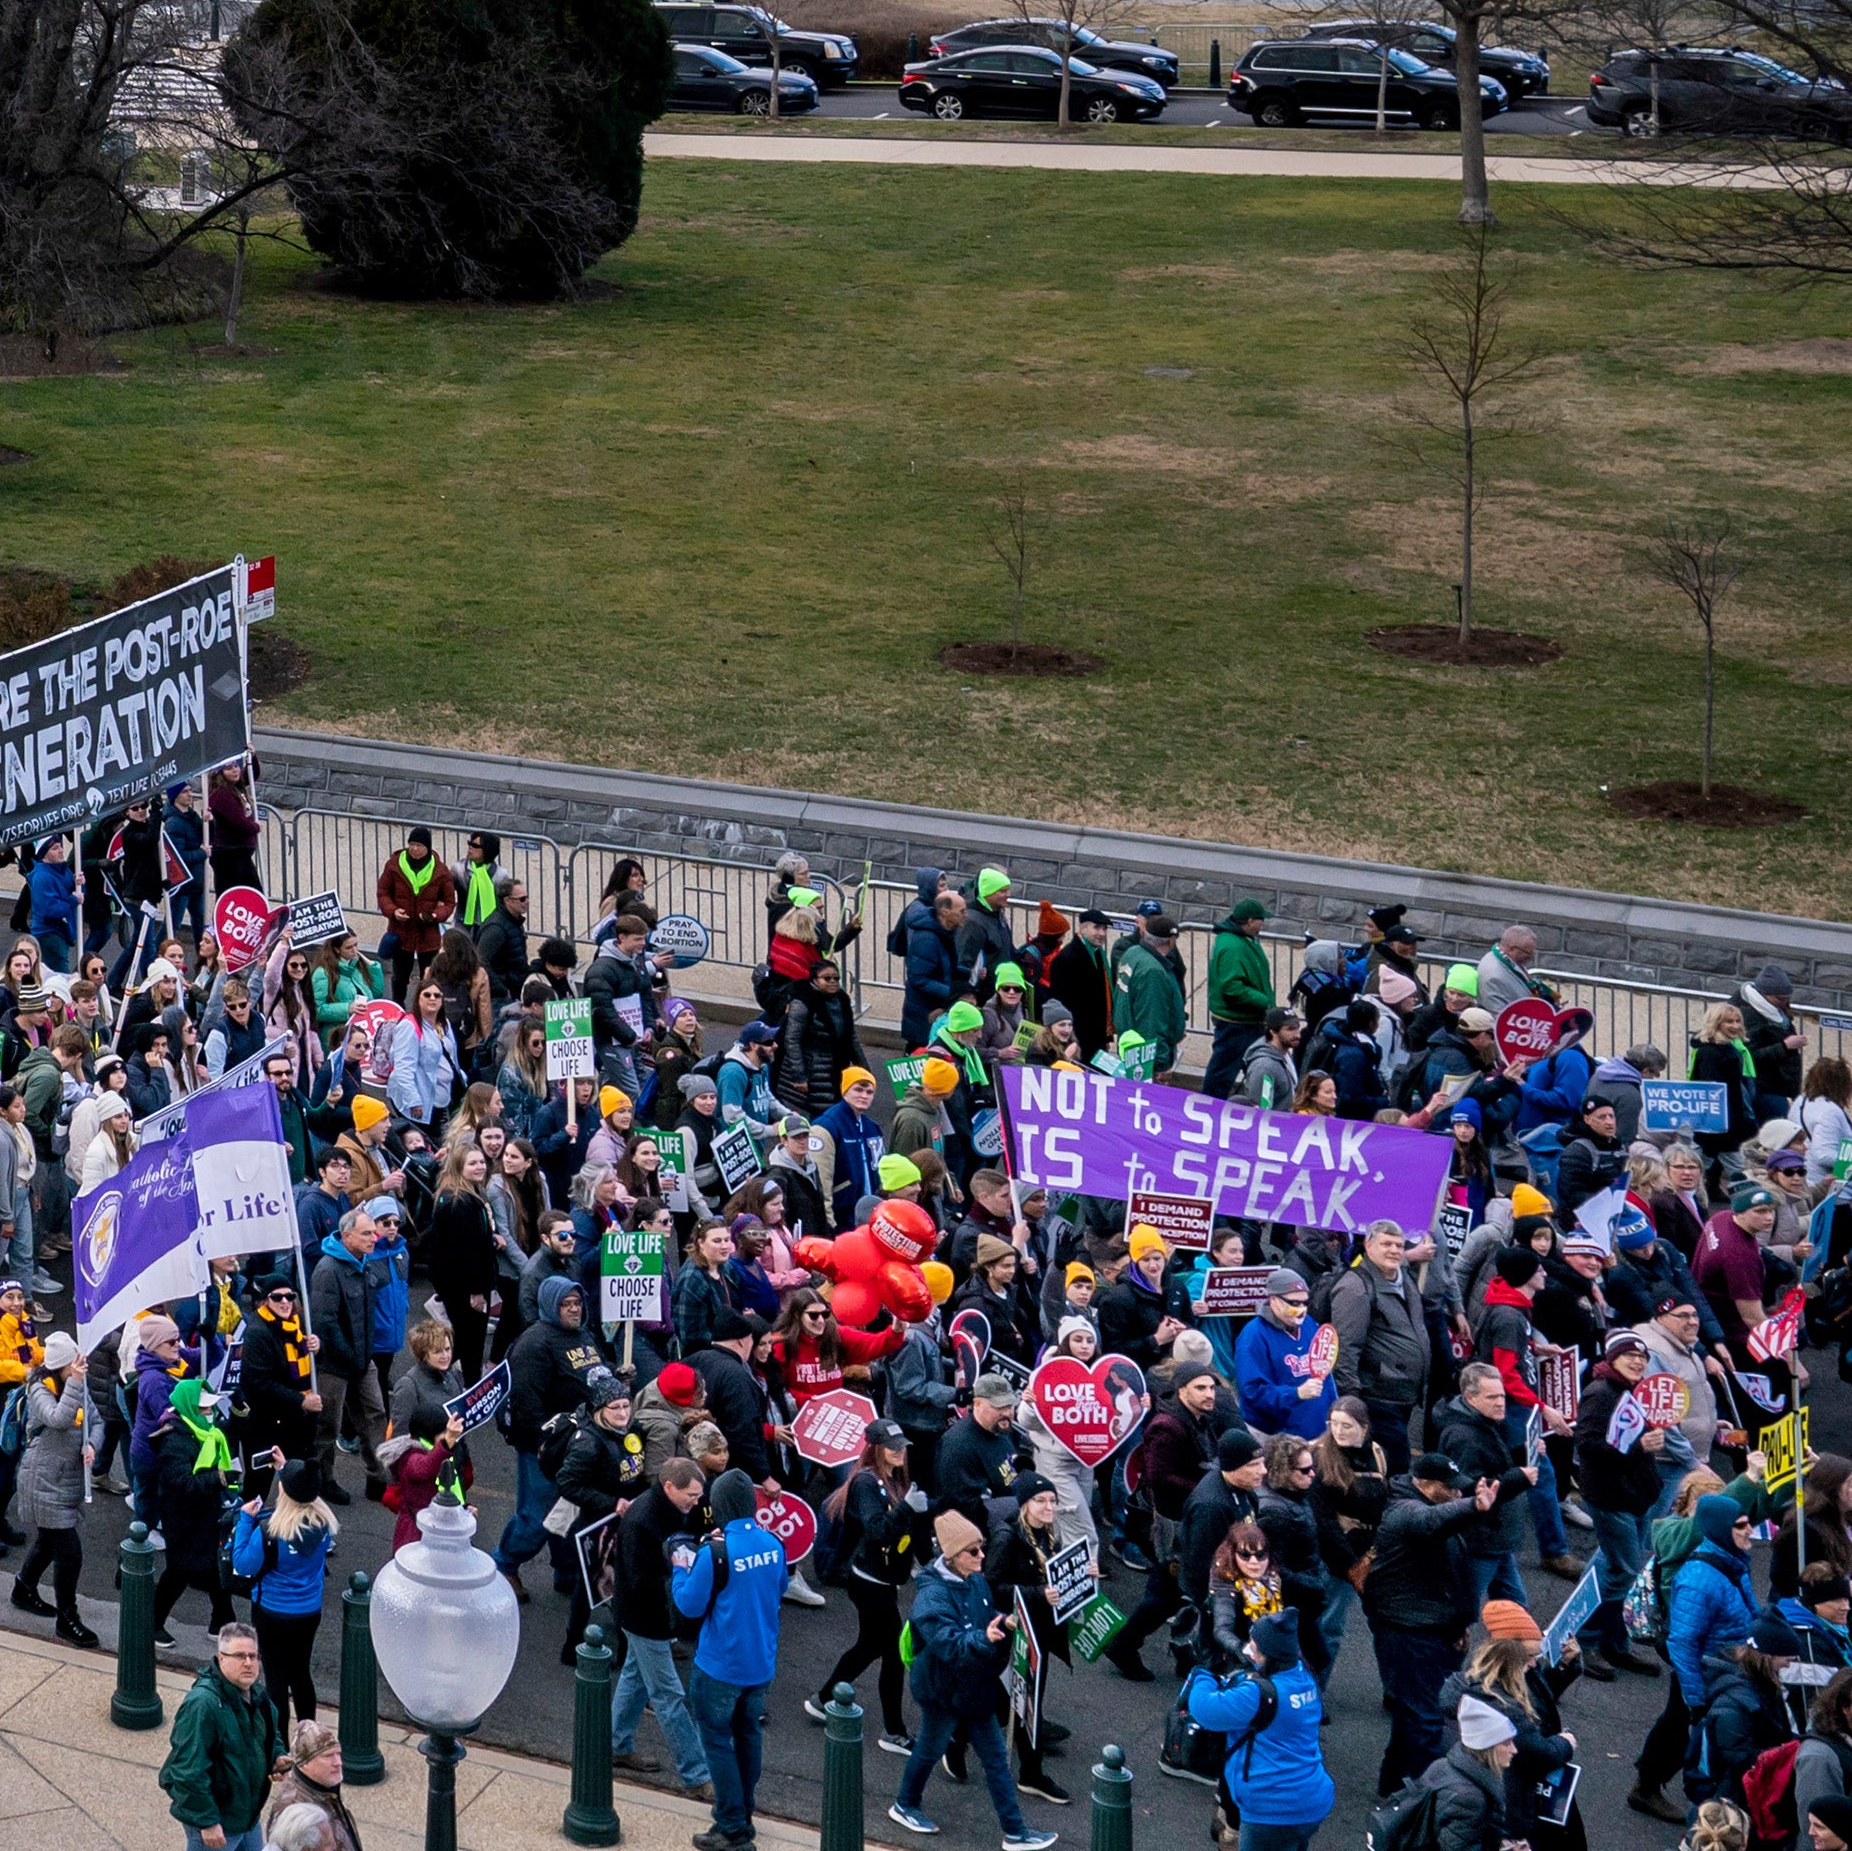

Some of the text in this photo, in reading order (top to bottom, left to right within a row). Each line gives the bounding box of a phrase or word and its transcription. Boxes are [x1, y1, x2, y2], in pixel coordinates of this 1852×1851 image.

[39, 646, 97, 714] THE
[105, 590, 233, 690] POST-ROE
[107, 784, 129, 802] TEXT
[131, 776, 148, 794] LIFE
[225, 901, 266, 927] LOVE
[296, 898, 333, 918] AM THE
[288, 909, 339, 928] POST-ROE
[668, 920, 692, 928] PRAY
[222, 916, 263, 946] BOTH
[293, 920, 342, 940] GENERATION
[678, 930, 698, 938] END
[654, 936, 703, 947] ABORTION
[547, 1001, 590, 1021] LOVE LIFE
[1507, 1014, 1553, 1033] LOVE
[551, 1039, 588, 1059] CHOOSE
[1504, 1031, 1552, 1050] BOTH
[560, 1058, 580, 1076] LIFE
[1021, 1067, 1115, 1124] NOT
[1127, 1087, 1162, 1136] to
[1647, 1087, 1706, 1100] WE VOTE
[1647, 1099, 1720, 1115] PRO-LIFE
[658, 1136, 681, 1154] LIFE
[1018, 1124, 1084, 1188] IS
[1123, 1152, 1161, 1192] to
[224, 1193, 288, 1223] Life!
[1149, 1202, 1203, 1217] DEMAND
[1130, 1213, 1210, 1230] PROTECTION
[1625, 1219, 1647, 1233] FLINT
[607, 1234, 662, 1254] LOVE LIFE
[610, 1278, 654, 1297] CHOOSE
[620, 1298, 642, 1318] LIFE
[466, 1379, 494, 1406] EVERY
[1044, 1383, 1095, 1402] LOVE
[1649, 1378, 1676, 1393] LET
[465, 1383, 502, 1418] PERSON
[1637, 1392, 1685, 1409] LIFE
[1052, 1407, 1108, 1424] BOTH
[734, 1550, 779, 1572] STAFF
